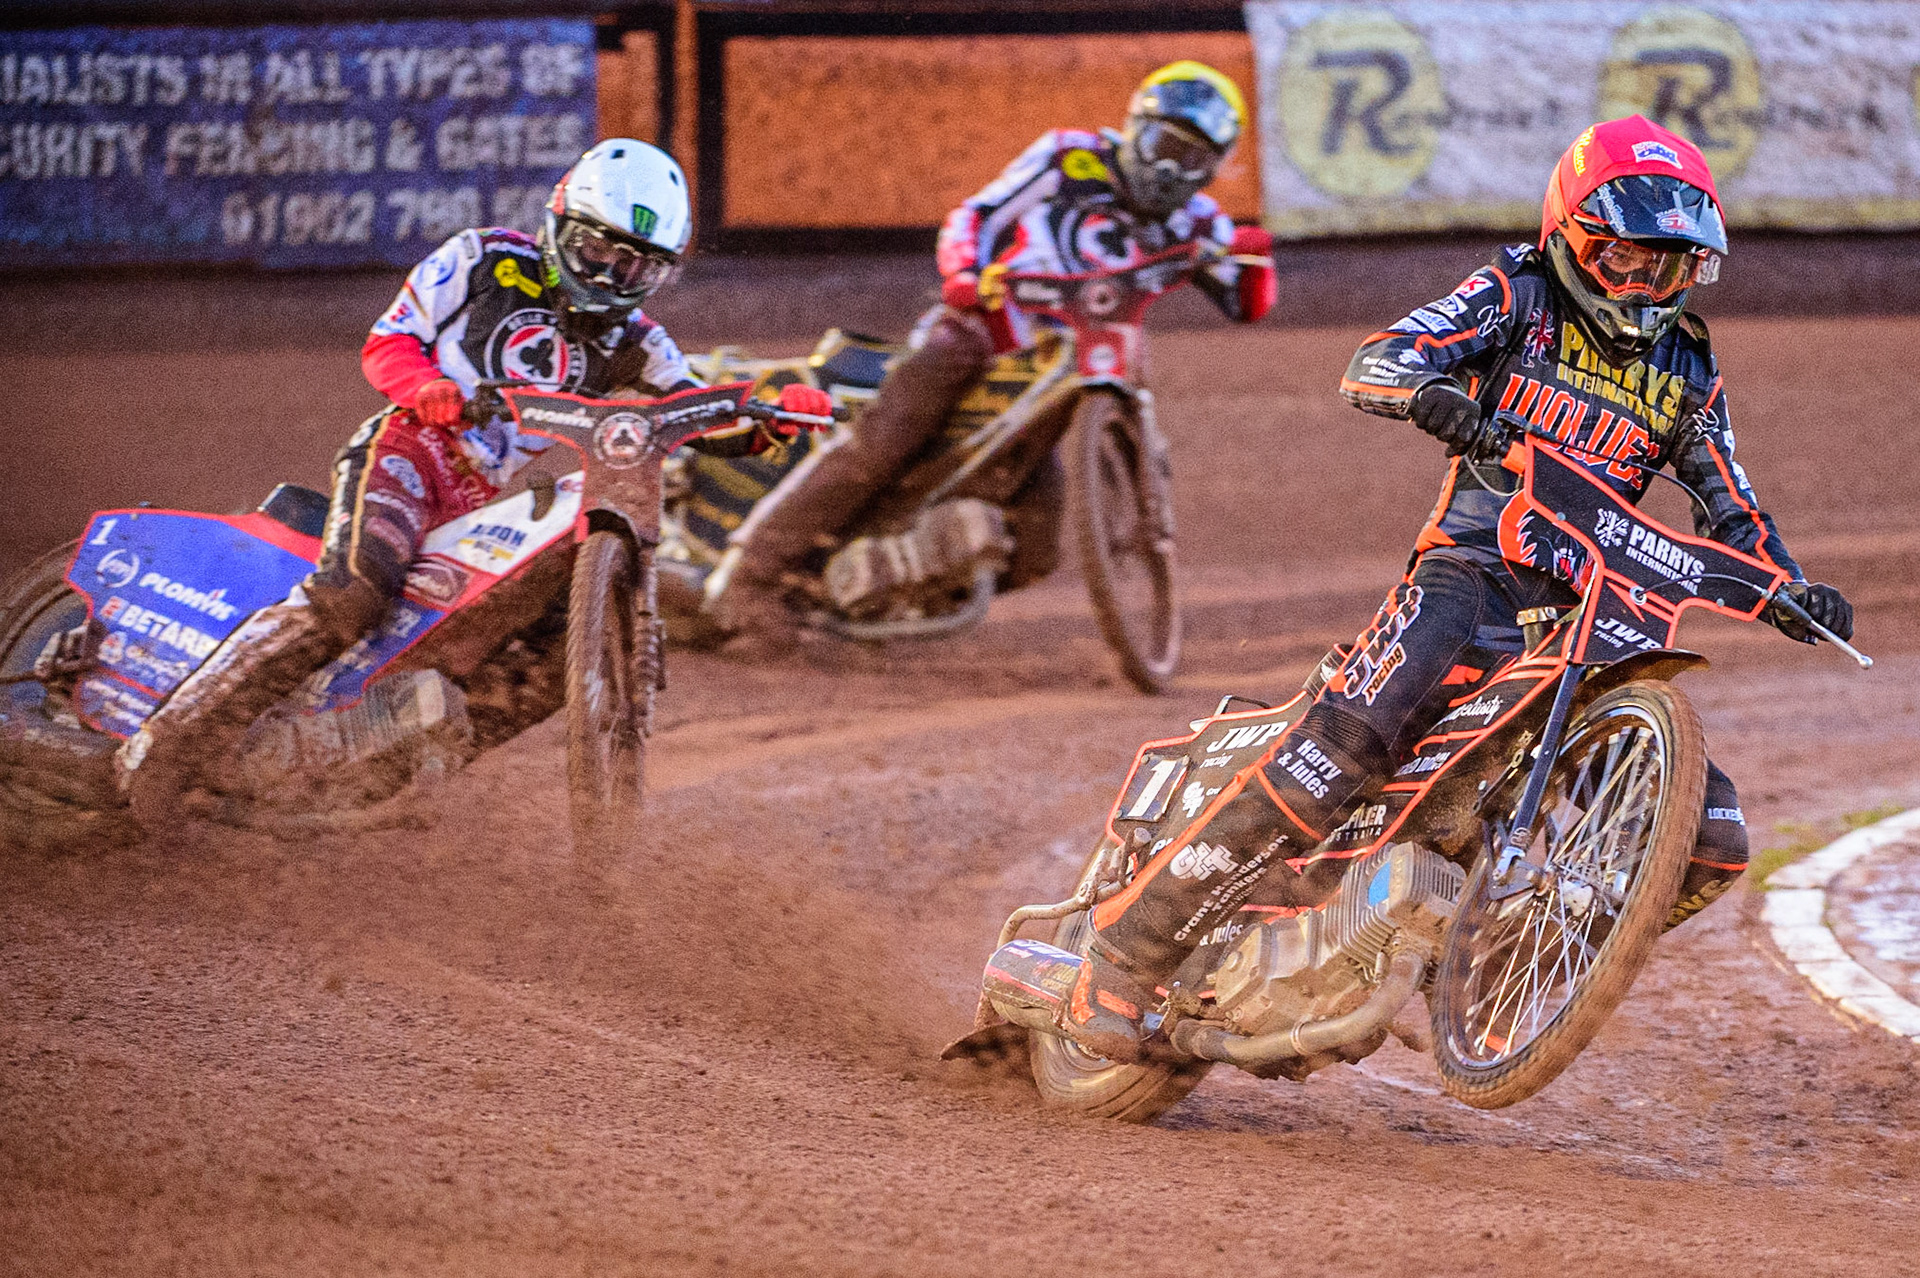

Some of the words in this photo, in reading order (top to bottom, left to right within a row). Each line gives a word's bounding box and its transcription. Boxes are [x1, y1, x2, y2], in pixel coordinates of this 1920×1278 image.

[264, 48, 351, 103] ALL
[361, 43, 511, 99] TYPES
[164, 119, 376, 177] FENCING
[436, 114, 585, 169] GATES
[89, 518, 118, 546] 1
[1628, 524, 1706, 583] PARRYS
[1594, 617, 1663, 650] JWP
[1363, 643, 1406, 704] racing
[1206, 721, 1289, 753] JWP
[1296, 738, 1343, 782] Harry
[1127, 760, 1177, 817] 1
[1277, 752, 1293, 767] &
[1286, 761, 1330, 799] Jules
[1173, 899, 1214, 942] Grant
[1211, 834, 1290, 896] Henderson
[1211, 867, 1268, 912] Tankers
